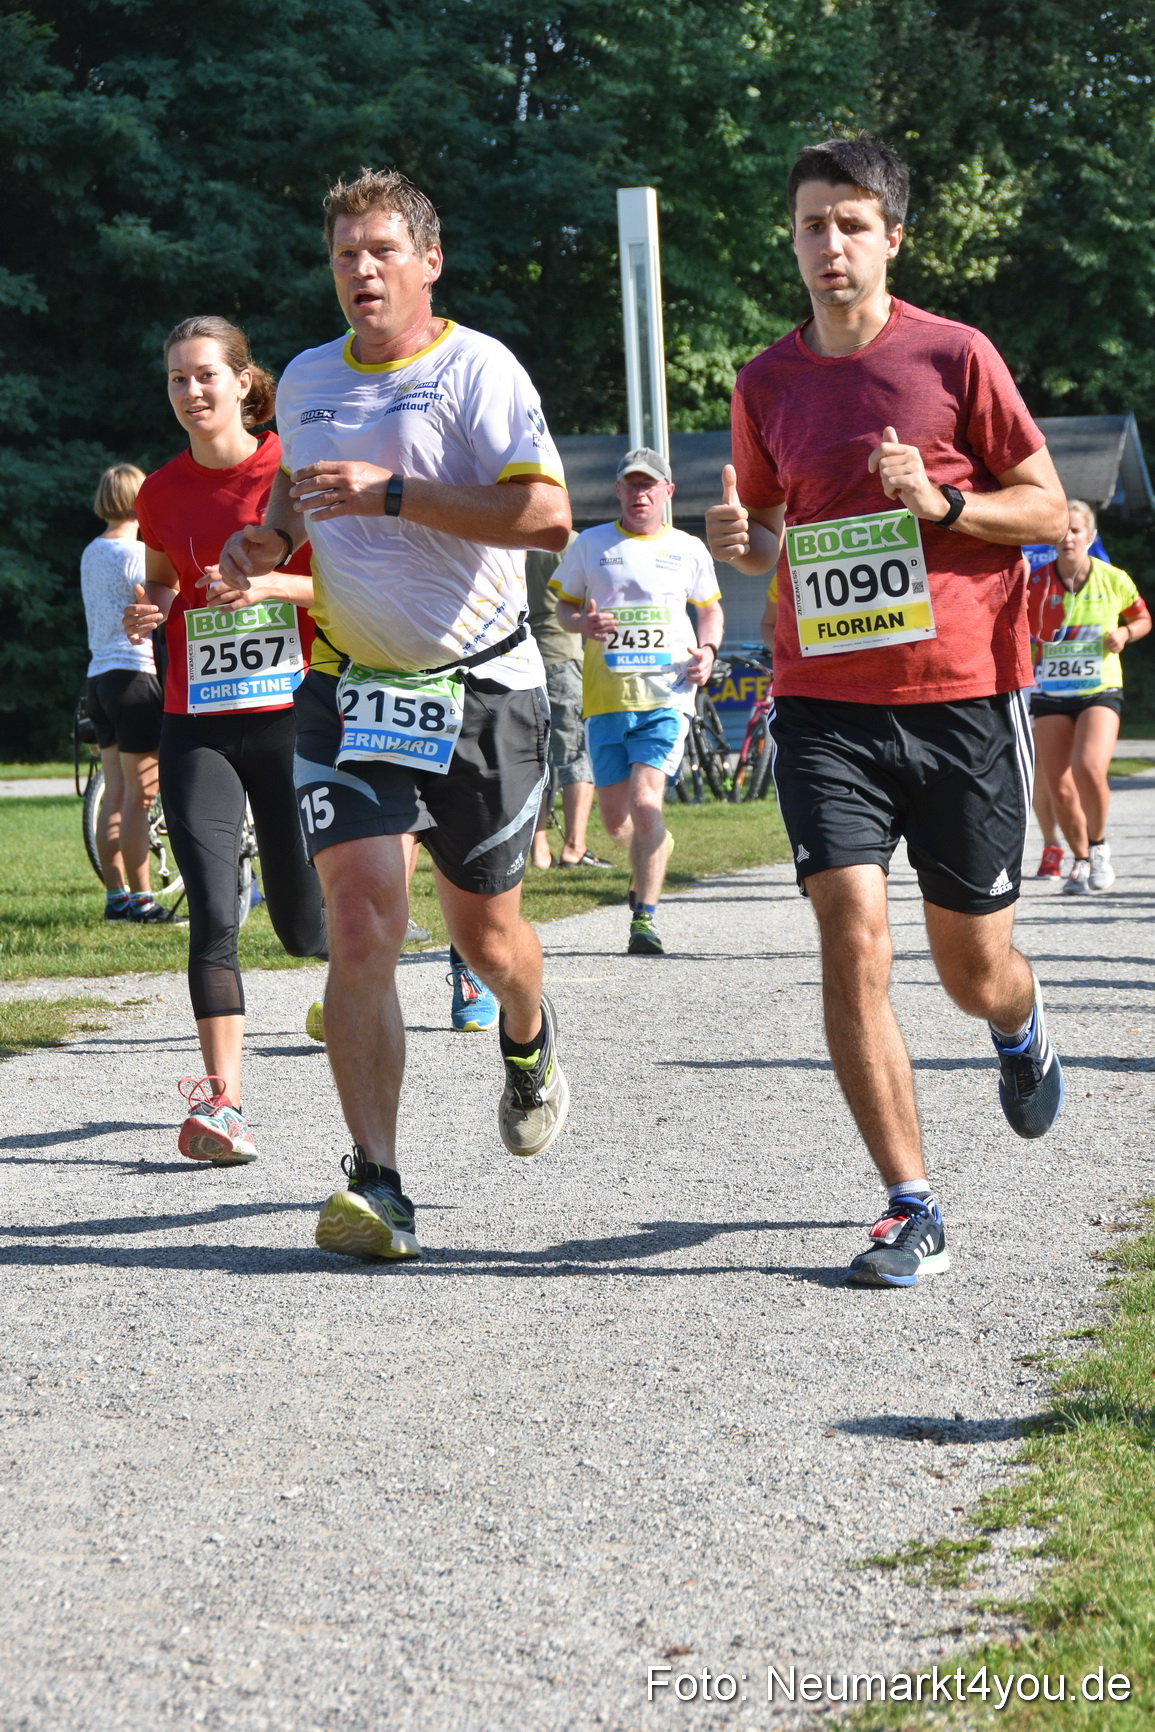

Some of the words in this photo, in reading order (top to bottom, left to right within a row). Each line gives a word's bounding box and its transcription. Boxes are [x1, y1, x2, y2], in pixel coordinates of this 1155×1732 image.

[301, 409, 336, 421] BOCK
[795, 519, 902, 557] BOCK
[805, 559, 910, 609] 1090
[194, 604, 284, 634] BOCK
[817, 611, 905, 639] FLORIAN
[606, 628, 665, 650] 2432
[1044, 642, 1096, 656] BOCK
[199, 636, 285, 676] 2567
[617, 655, 656, 664] KLAUS
[1047, 660, 1095, 678] 2845
[200, 677, 293, 700] CHRISTINE
[341, 689, 446, 732] 2158
[343, 732, 439, 757] ERNHARD
[301, 786, 335, 834] 15
